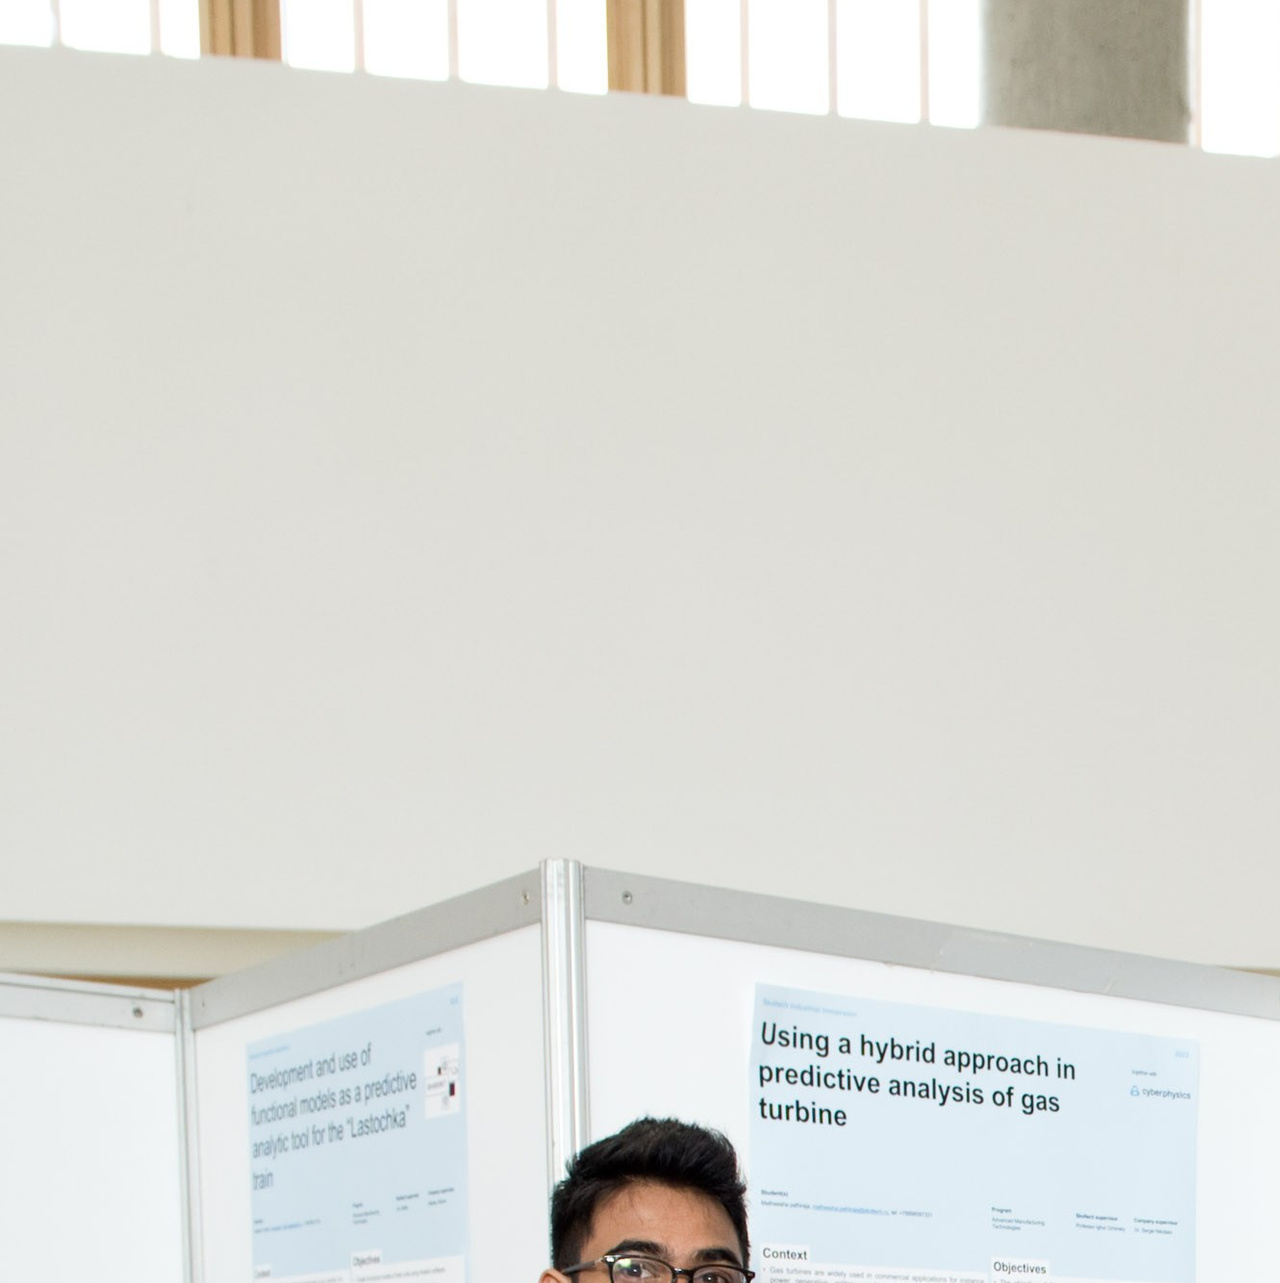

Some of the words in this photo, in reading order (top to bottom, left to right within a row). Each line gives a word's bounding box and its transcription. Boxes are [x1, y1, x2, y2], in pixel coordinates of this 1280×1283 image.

[762, 1022, 829, 1057] Using
[839, 1038, 851, 1054] a
[861, 1034, 935, 1064] hybrid
[944, 1050, 1048, 1076] approach
[1057, 1058, 1075, 1080] in
[251, 1060, 314, 1094] Development
[316, 1053, 336, 1077] and
[339, 1052, 358, 1072] use
[361, 1042, 371, 1066] of
[251, 1097, 297, 1126] functional
[300, 1089, 336, 1114] models
[339, 1088, 352, 1106] as
[355, 1086, 361, 1103] a
[364, 1071, 417, 1104] predictive
[759, 1065, 880, 1093] predictive
[889, 1078, 984, 1106] analysis
[992, 1087, 1014, 1107] of
[1022, 1094, 1059, 1115] gas
[1142, 1087, 1191, 1100] cyberphysics
[759, 1098, 846, 1126] turbine
[253, 1134, 289, 1159] analytic
[291, 1127, 309, 1150] tool
[312, 1125, 325, 1146] for
[328, 1122, 344, 1142] the
[252, 1169, 274, 1190] train
[763, 1248, 807, 1260] Context
[994, 1262, 1046, 1274] Objectives
